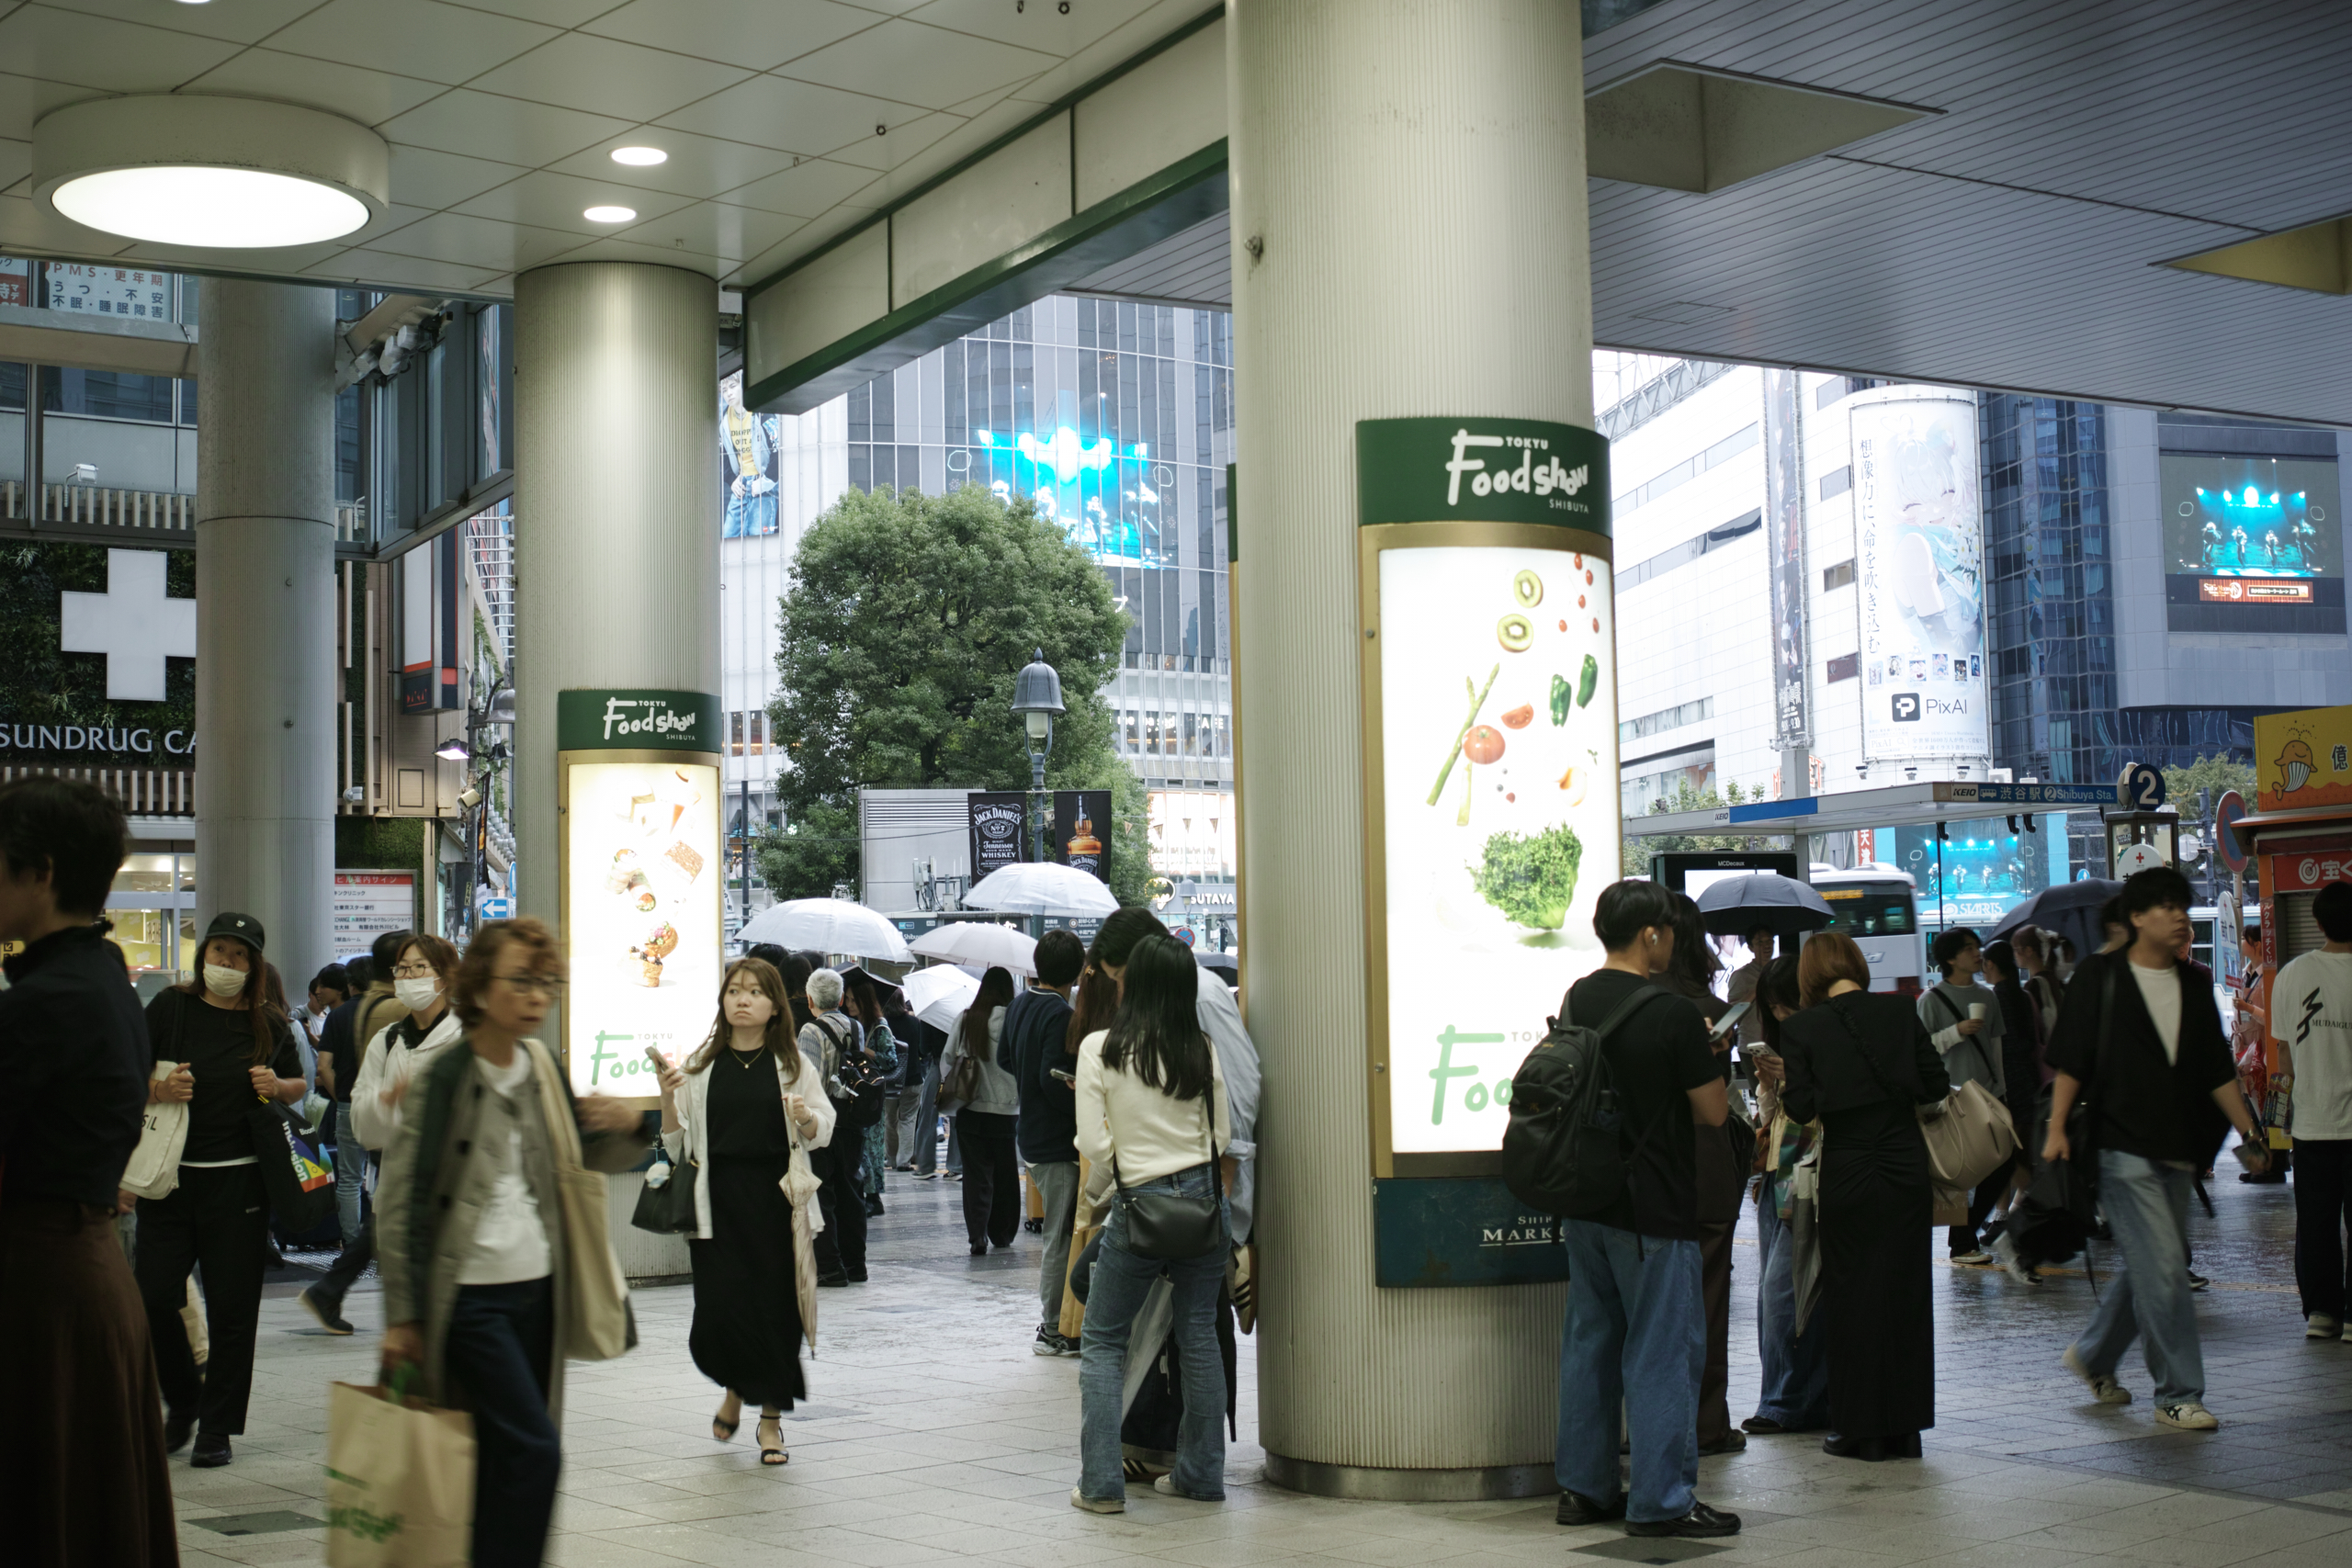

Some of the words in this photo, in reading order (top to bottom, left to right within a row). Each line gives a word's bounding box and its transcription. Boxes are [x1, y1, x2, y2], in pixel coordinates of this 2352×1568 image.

[54, 280, 164, 305] うつ・不安
[52, 294, 164, 319] 不眠・睡眠障害
[1506, 435, 1548, 450] TOKYU
[1549, 498, 1589, 514] SHIBUYA
[1860, 438, 1880, 655] 想像力に、命を吹き込む
[1926, 698, 1967, 715] PixAI
[0, 723, 153, 753] SUNDRUG
[1953, 788, 1977, 797] KEIO
[2000, 786, 2041, 801] 渋谷駅
[2057, 788, 2095, 802] Shibuya
[2096, 790, 2114, 800] Sta.
[2137, 770, 2159, 806] 2
[974, 810, 993, 826] JACK
[1714, 813, 1729, 821] KEIO
[983, 840, 1014, 850] Tennessee
[1511, 1031, 1550, 1043] TOK
